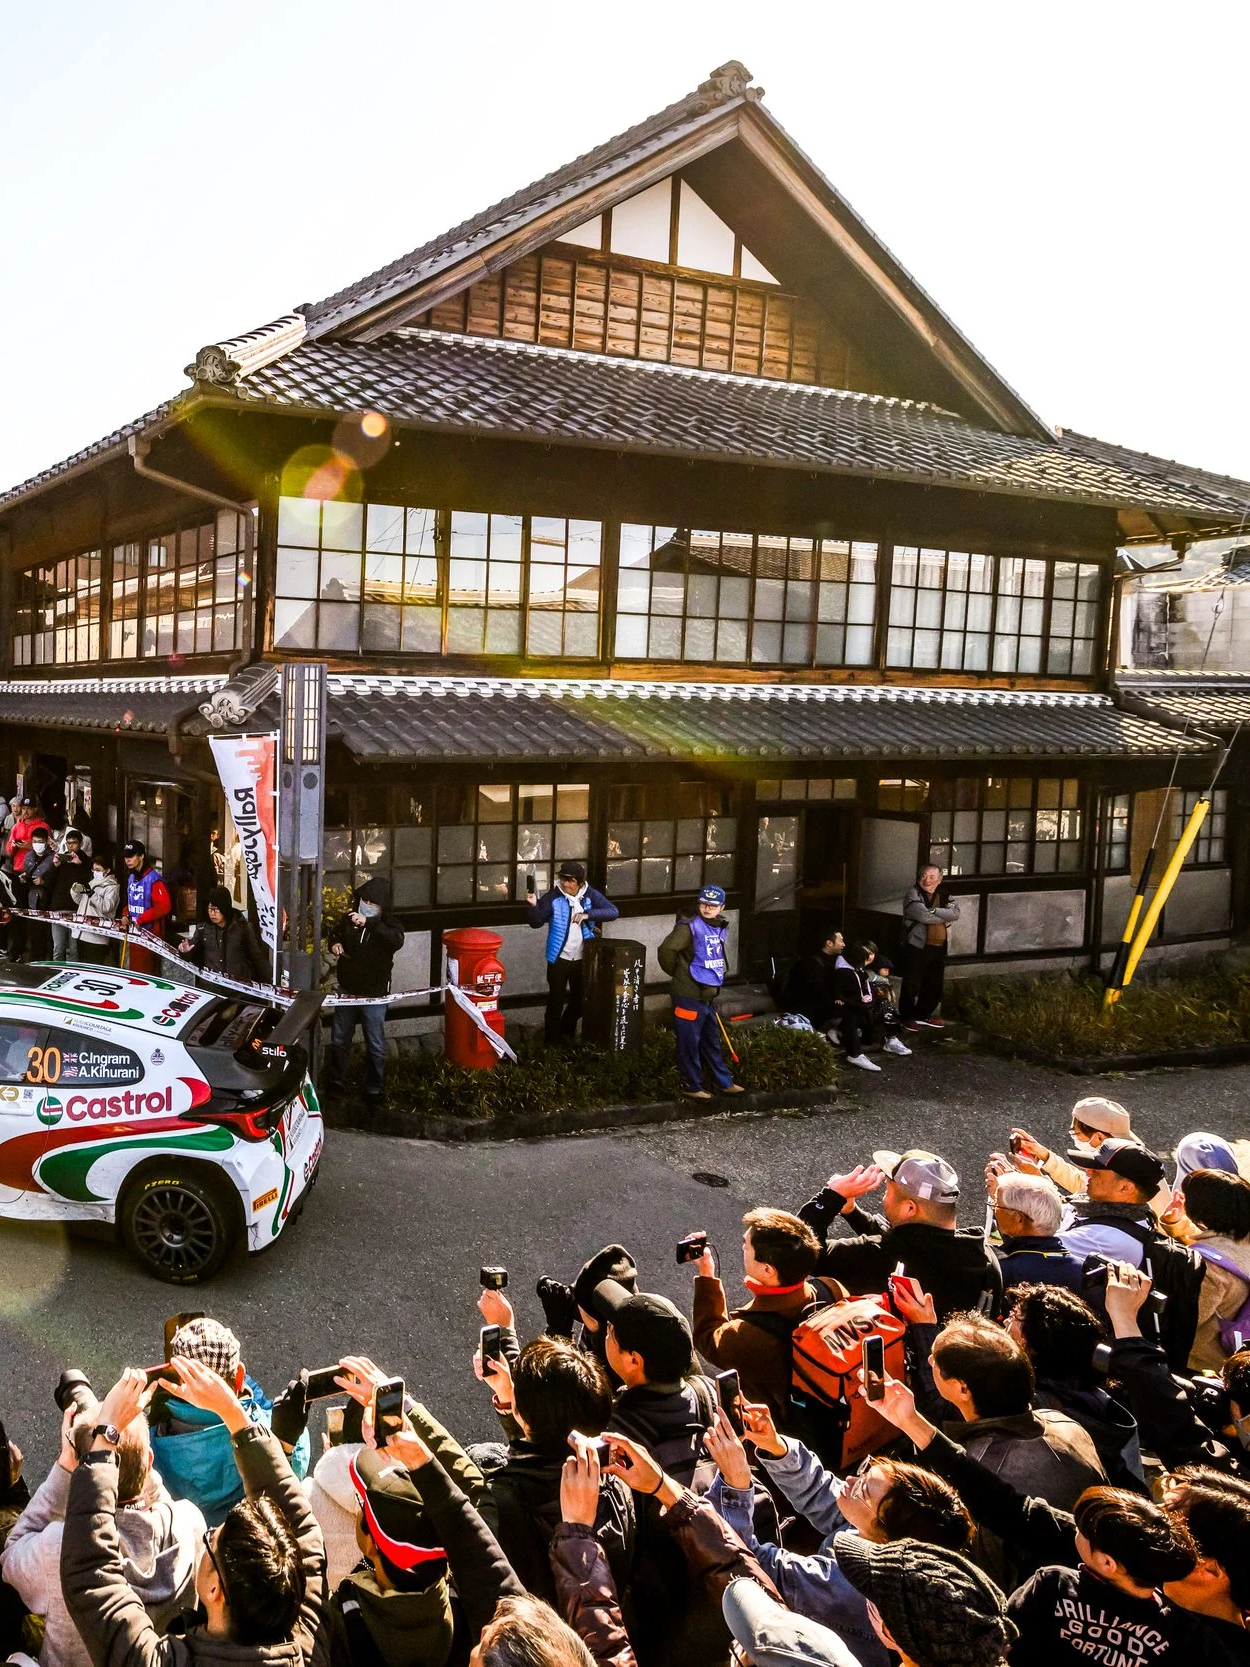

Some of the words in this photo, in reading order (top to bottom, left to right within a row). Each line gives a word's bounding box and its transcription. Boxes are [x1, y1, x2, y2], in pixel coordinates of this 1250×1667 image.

[74, 979, 124, 996] 30
[26, 1046, 61, 1084] 30
[78, 1052, 130, 1066] C.Ingram
[78, 1064, 139, 1079] A.Kihurani
[66, 1086, 172, 1121] Castrol
[253, 1188, 278, 1212] PIRELLI
[1068, 1620, 1144, 1656] GOOD
